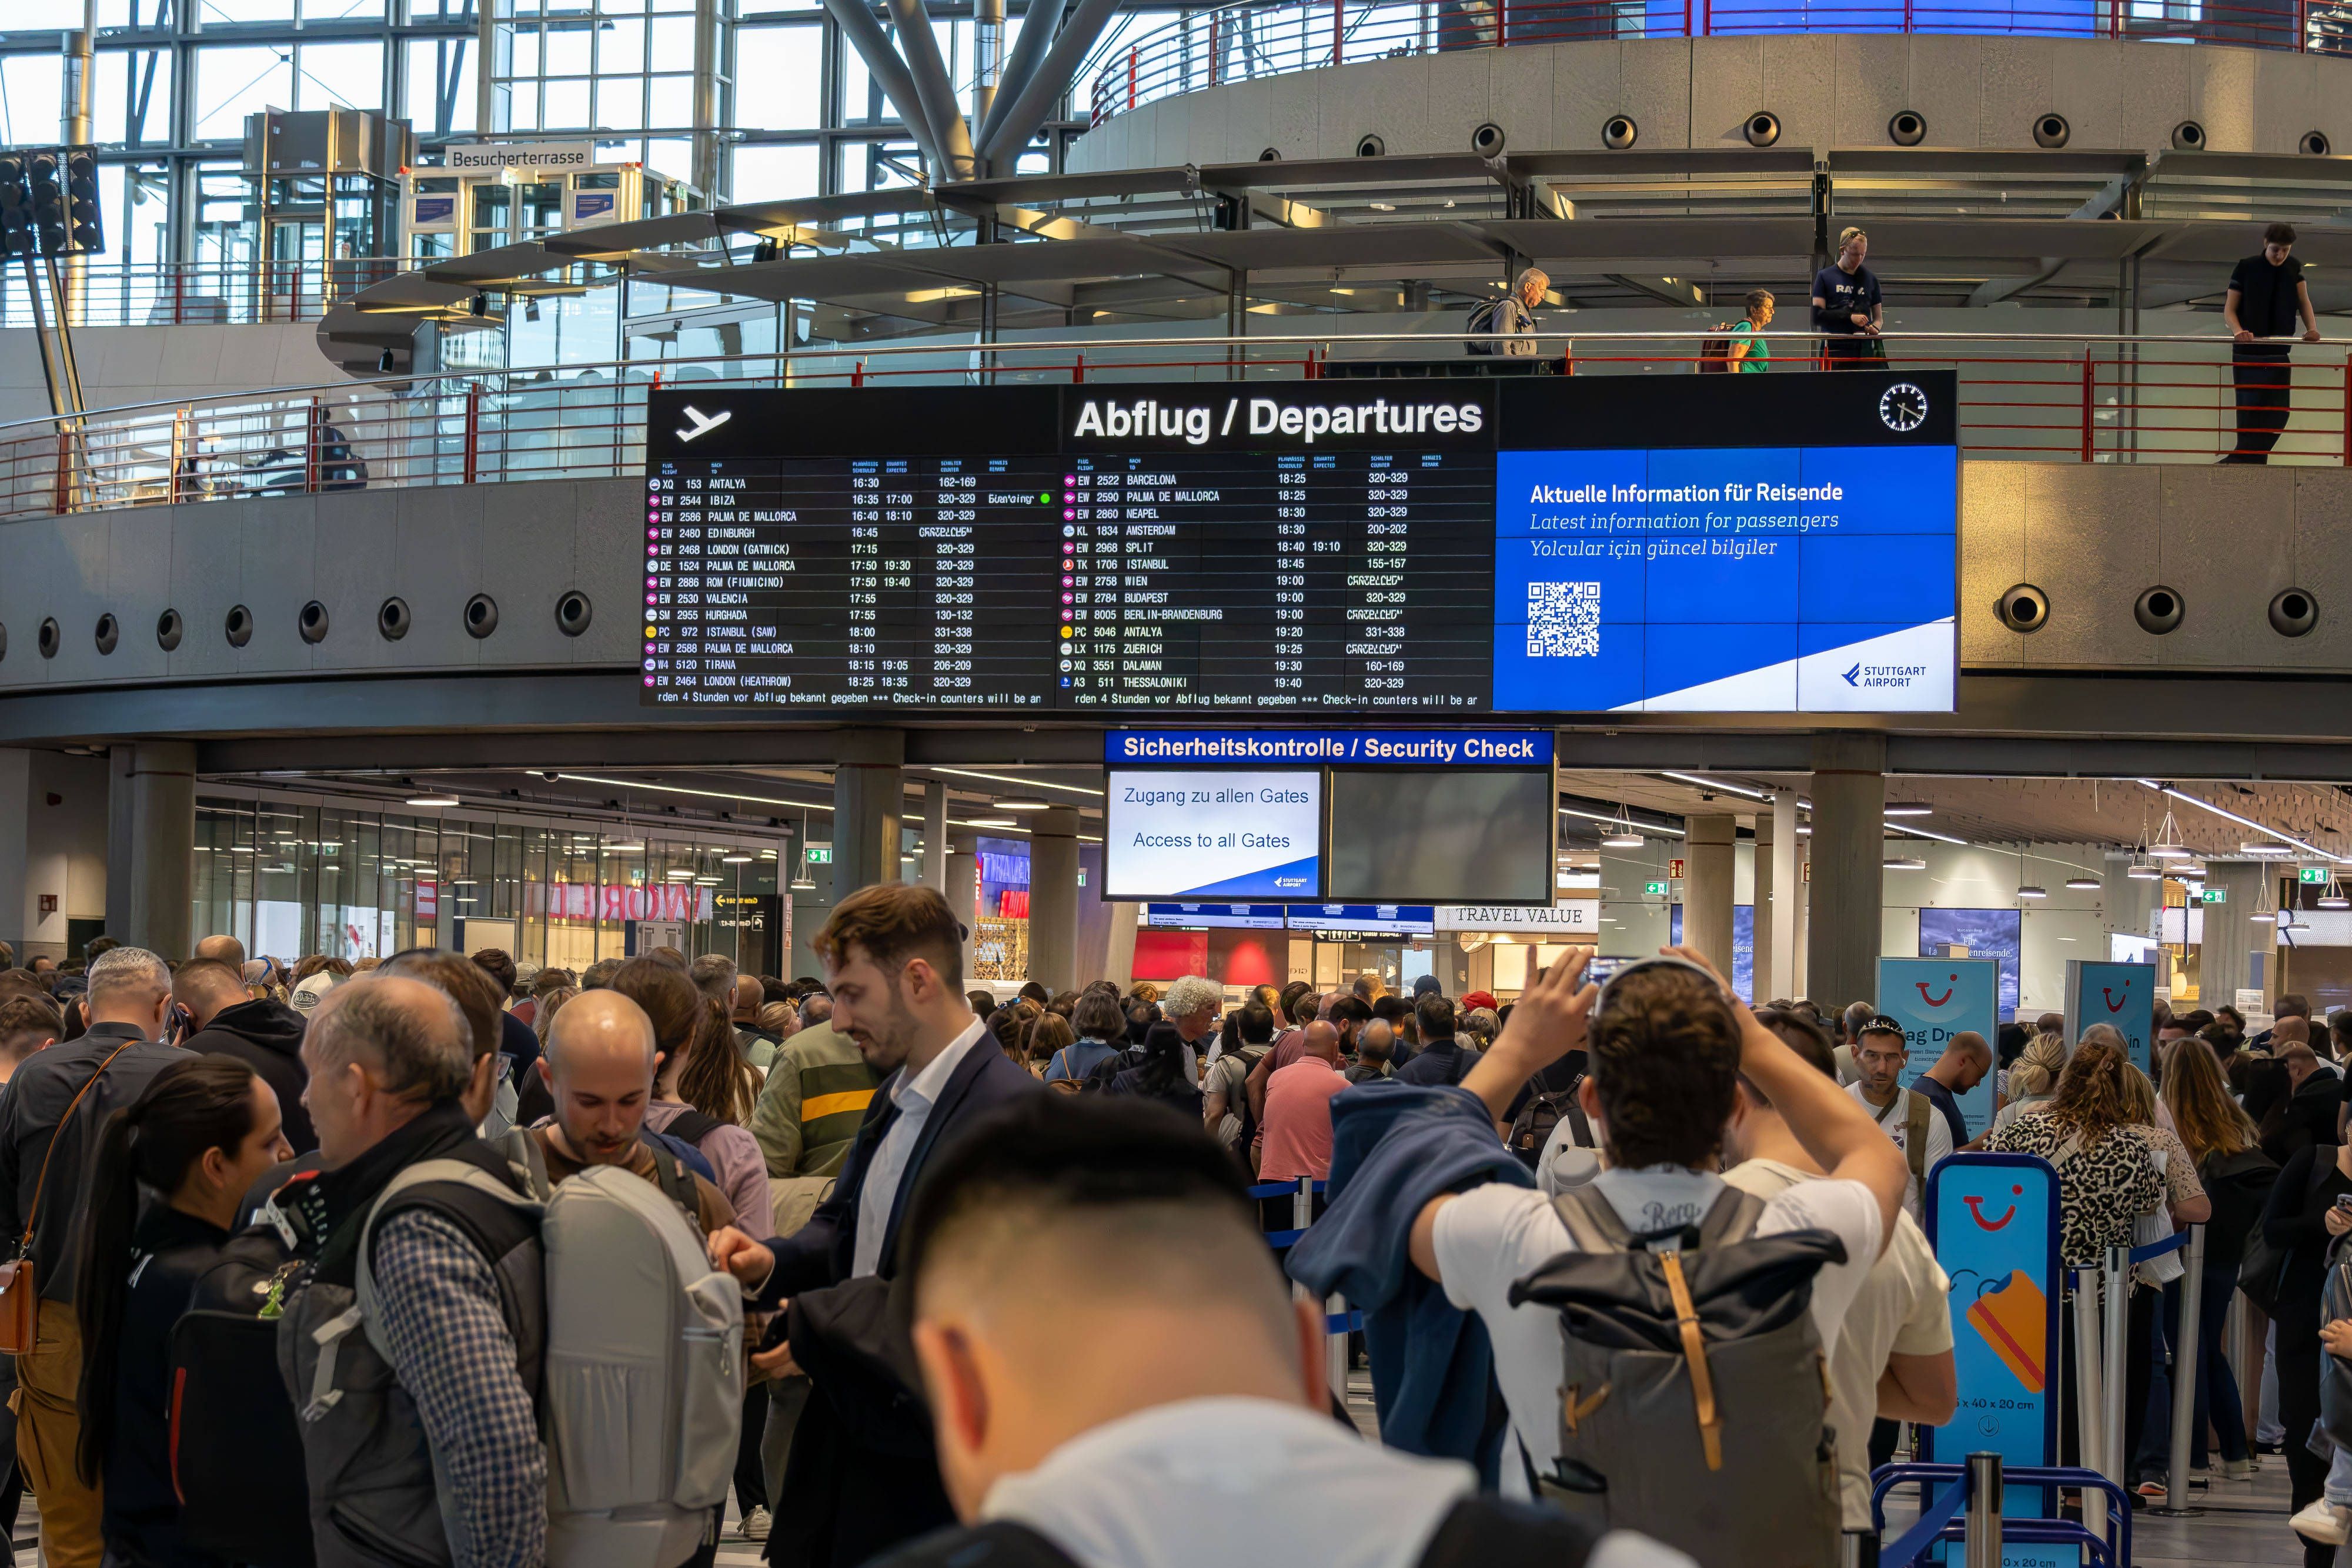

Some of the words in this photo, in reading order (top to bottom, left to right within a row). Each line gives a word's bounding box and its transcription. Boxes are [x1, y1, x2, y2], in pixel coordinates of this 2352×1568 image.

[453, 150, 584, 167] Besucherterrasse
[1074, 400, 1210, 445] Abflug
[1221, 398, 1239, 436] /
[1250, 398, 1482, 443] Departures
[662, 479, 674, 490] XQ
[686, 479, 702, 489] 153
[709, 478, 746, 489] ANTALYA
[853, 477, 880, 488] 16:30
[938, 477, 976, 488] 162-169
[1078, 475, 1090, 486] EW
[1097, 474, 1120, 486] 2522
[1127, 474, 1177, 486] BARCELONA
[1278, 473, 1306, 484] 18:25
[1368, 472, 1408, 483] 320-329
[662, 495, 674, 506] EW
[680, 495, 701, 506] 2544
[710, 494, 736, 506] IBIZA
[852, 494, 879, 504] 16:35
[886, 494, 913, 505] 17:00
[938, 493, 975, 504] 320-329
[1530, 483, 1607, 504] Aktuelle
[1612, 483, 1720, 503] Information
[1723, 482, 1755, 503] für
[1756, 482, 1843, 502] Reisende
[1529, 513, 1586, 531] Latest
[1590, 511, 1700, 530] information
[1703, 511, 1732, 534] for
[1735, 513, 1839, 534] passengers
[1077, 526, 1088, 536] KL
[1096, 525, 1118, 536] 1834
[1125, 524, 1176, 536] AMSTERDAM
[1277, 523, 1305, 535] 18:30
[1367, 523, 1407, 534] 200-202
[660, 544, 673, 555] EW
[679, 544, 700, 555] 2468
[707, 544, 739, 555] LONDON
[743, 543, 790, 556] (GATWICK)
[851, 544, 878, 554] 17:15
[937, 543, 974, 554] 320-329
[1076, 543, 1089, 553] EW
[1095, 542, 1118, 553] 2968
[1125, 541, 1154, 553] SPLIT
[1277, 540, 1305, 552] 18:40
[1312, 541, 1341, 551] 19:10
[1367, 541, 1406, 551] 320-329
[1531, 539, 1603, 557] Yolcular
[1608, 539, 1641, 561] için
[1647, 539, 1707, 561] güncel
[1712, 538, 1778, 560] bilgiler
[1076, 559, 1088, 570] TK
[1095, 559, 1118, 570] 1706
[1127, 559, 1169, 570] ISTANBUL
[1277, 558, 1304, 569] 18:45
[1367, 558, 1406, 569] 155-157
[660, 577, 671, 588] EW
[677, 577, 699, 587] 2886
[706, 577, 723, 587] ROM
[727, 576, 783, 589] (FIUMICINO)
[850, 577, 877, 587] 17:50
[884, 576, 910, 587] 19:40
[936, 576, 974, 587] 320-329
[1075, 609, 1087, 620] EW
[1094, 609, 1117, 620] 8005
[1124, 609, 1222, 620] BERLIN-BRANDENBURG
[1275, 609, 1304, 620] 19:00
[659, 626, 670, 637] PC
[681, 626, 698, 637] 972
[707, 626, 747, 637] ISTANBUL
[751, 626, 777, 638] (SAW)
[848, 626, 876, 637] 18:00
[934, 627, 973, 637] 331-338
[1074, 643, 1086, 654] LX
[1094, 643, 1116, 654] 1175
[1123, 643, 1162, 654] ZUERICH
[1275, 643, 1302, 654] 19:25
[657, 659, 669, 670] W4
[676, 659, 697, 670] 5120
[704, 659, 736, 670] TIRANA
[848, 660, 874, 670] 18:15
[881, 660, 908, 671] 19:05
[933, 660, 971, 671] 206-209
[1864, 667, 1926, 676] STUTTGART
[1073, 677, 1085, 687] A3
[1098, 677, 1114, 687] 511
[1122, 677, 1187, 688] THESSALONIKI
[1274, 677, 1302, 688] 19:40
[1364, 677, 1404, 688] 320-329
[1863, 678, 1911, 687] AIRPORT
[658, 692, 679, 702] rden
[682, 691, 689, 701] 4
[692, 691, 729, 702] Stunden
[733, 694, 749, 703] vor
[753, 692, 786, 704] Abflug
[790, 692, 826, 703] bekannt
[831, 693, 868, 704] gegeben
[893, 692, 936, 703] Check-in
[940, 694, 984, 704] counters
[987, 693, 1008, 703] will
[1014, 693, 1026, 704] be
[1124, 737, 1345, 758] Sicherheitskontrolle
[1351, 738, 1359, 758] /
[1364, 737, 1456, 763] Security
[1464, 737, 1534, 758] Check
[1124, 788, 1185, 807] Zugang
[1191, 791, 1211, 804] zu
[1215, 788, 1254, 804] allen
[1259, 788, 1309, 804] Gates
[1132, 832, 1192, 848] Access
[1197, 833, 1212, 848] to
[1218, 832, 1236, 848] all
[1241, 832, 1290, 848] Gates
[1456, 907, 1523, 922] TRAVEL
[1526, 909, 1582, 924] VALUE
[1906, 1030, 1927, 1045] ag
[1972, 1398, 1987, 1409] 40
[1999, 1399, 2014, 1409] 20
[2017, 1402, 2034, 1410] cm
[2001, 1557, 2011, 1568] 0
[2022, 1558, 2037, 1567] 20
